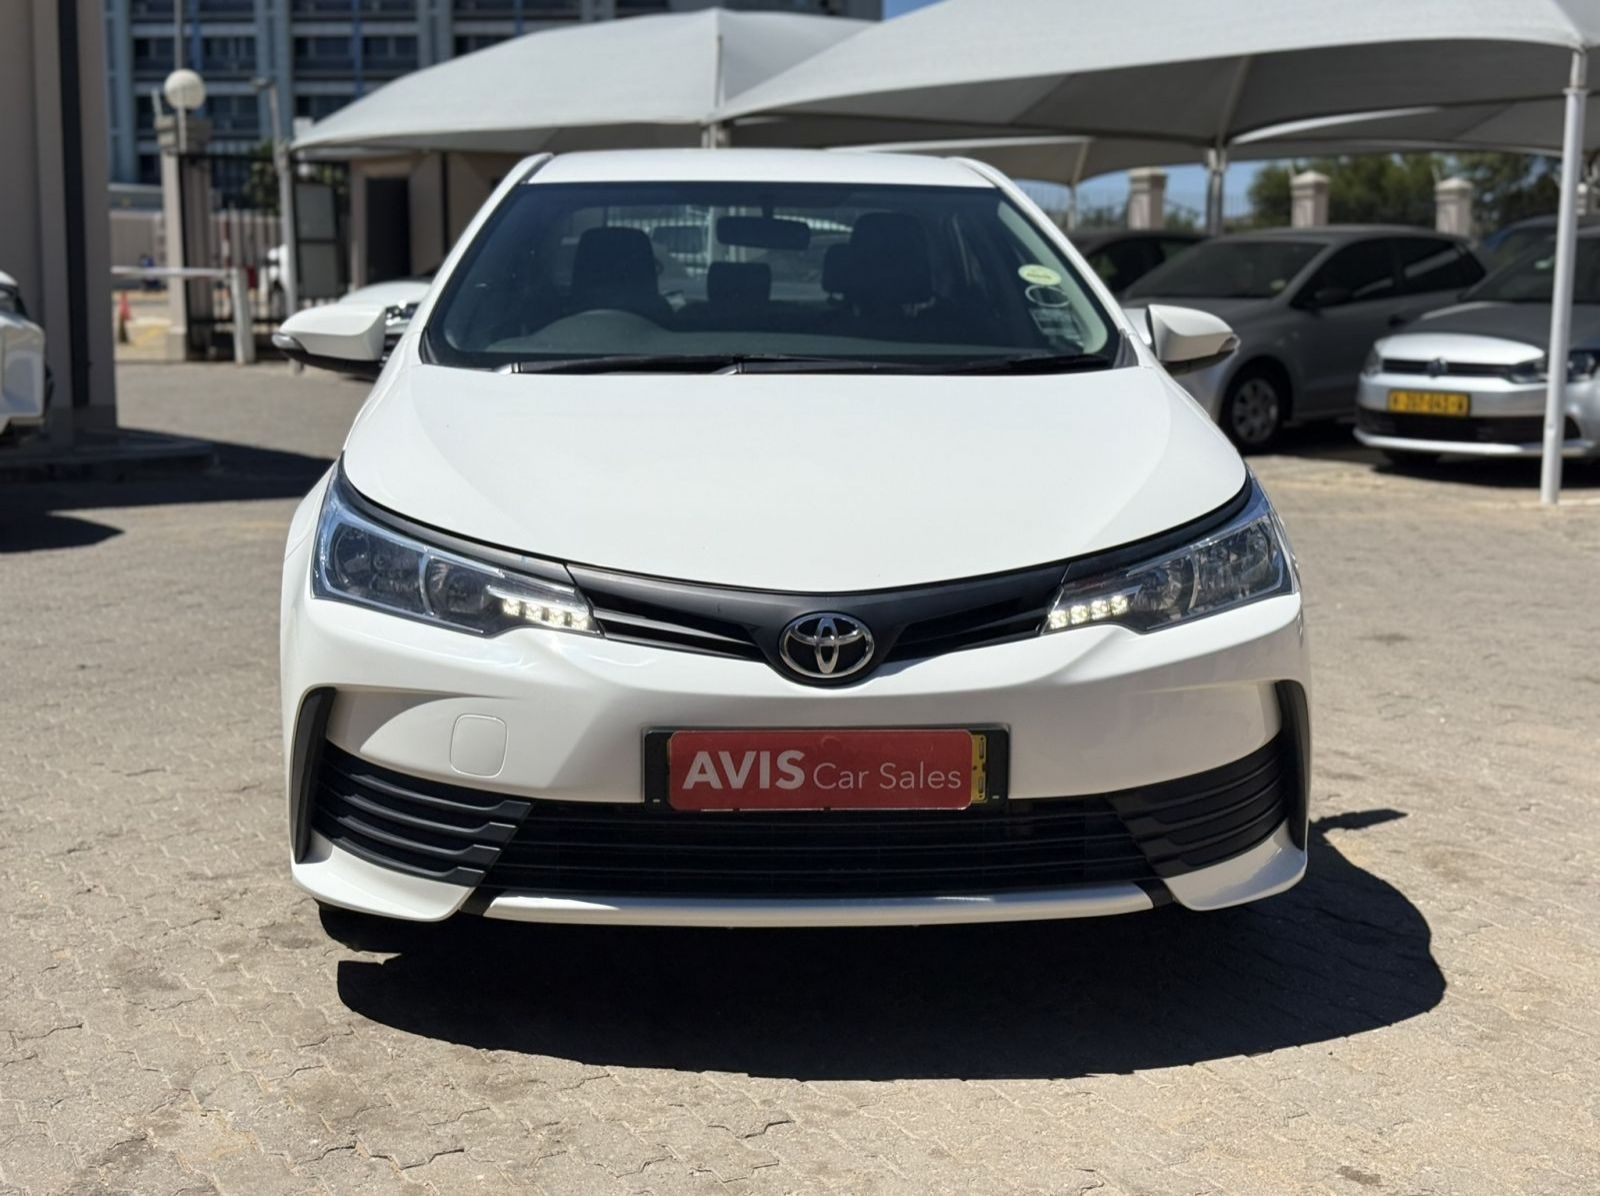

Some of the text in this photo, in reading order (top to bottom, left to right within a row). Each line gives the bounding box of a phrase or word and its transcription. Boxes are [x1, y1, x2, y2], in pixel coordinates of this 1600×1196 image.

[682, 749, 962, 790] AVIS Car Sales
